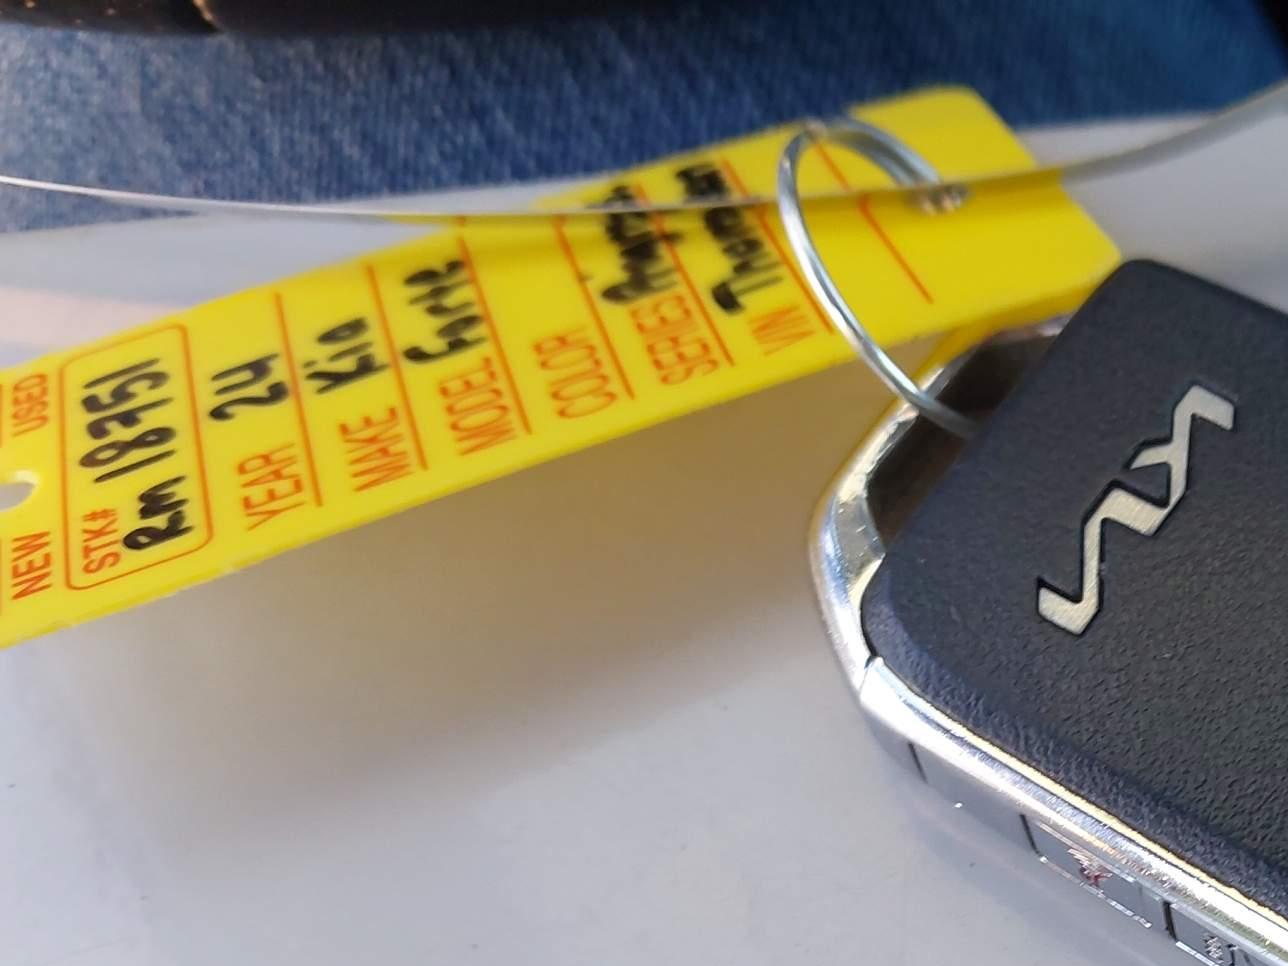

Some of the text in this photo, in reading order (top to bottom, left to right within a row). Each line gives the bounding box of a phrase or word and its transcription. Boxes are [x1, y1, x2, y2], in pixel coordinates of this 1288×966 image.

[302, 317, 391, 394] Kia
[629, 294, 719, 386] SERIES
[748, 304, 815, 356] VIN
[11, 372, 49, 437] USED
[208, 353, 289, 421] 24
[438, 355, 518, 456] MODEL
[533, 324, 618, 419] COLOR
[236, 441, 306, 532] YEAR
[338, 406, 414, 492] MAKE
[11, 531, 52, 600] NEW
[81, 508, 121, 574] STK#
